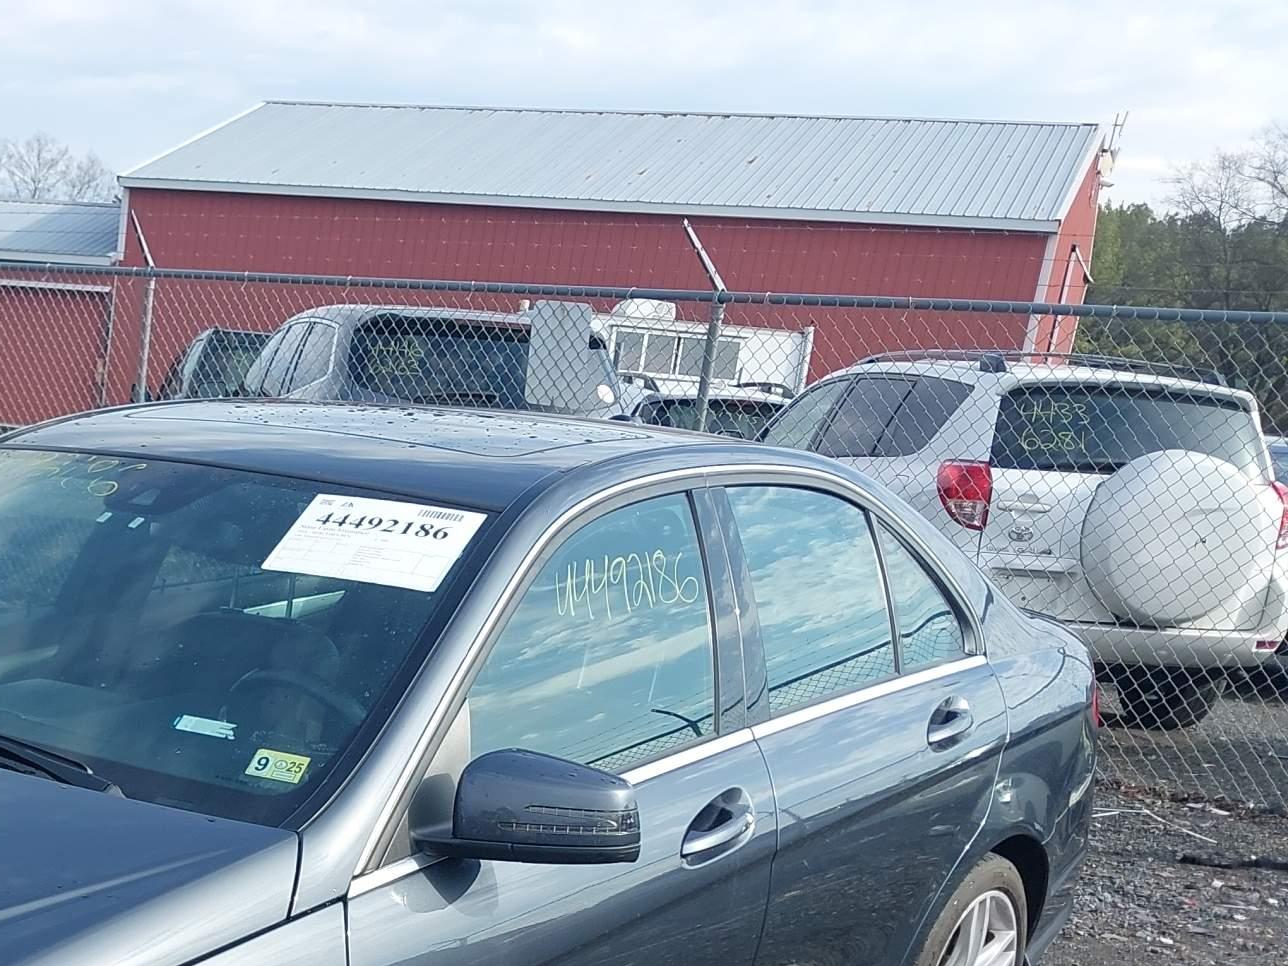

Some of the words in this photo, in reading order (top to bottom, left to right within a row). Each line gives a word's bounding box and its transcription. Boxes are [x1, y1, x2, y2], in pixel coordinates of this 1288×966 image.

[316, 511, 453, 540] 44492186
[556, 549, 699, 621] 44492186
[254, 756, 270, 771] 9
[286, 761, 305, 774] 25
